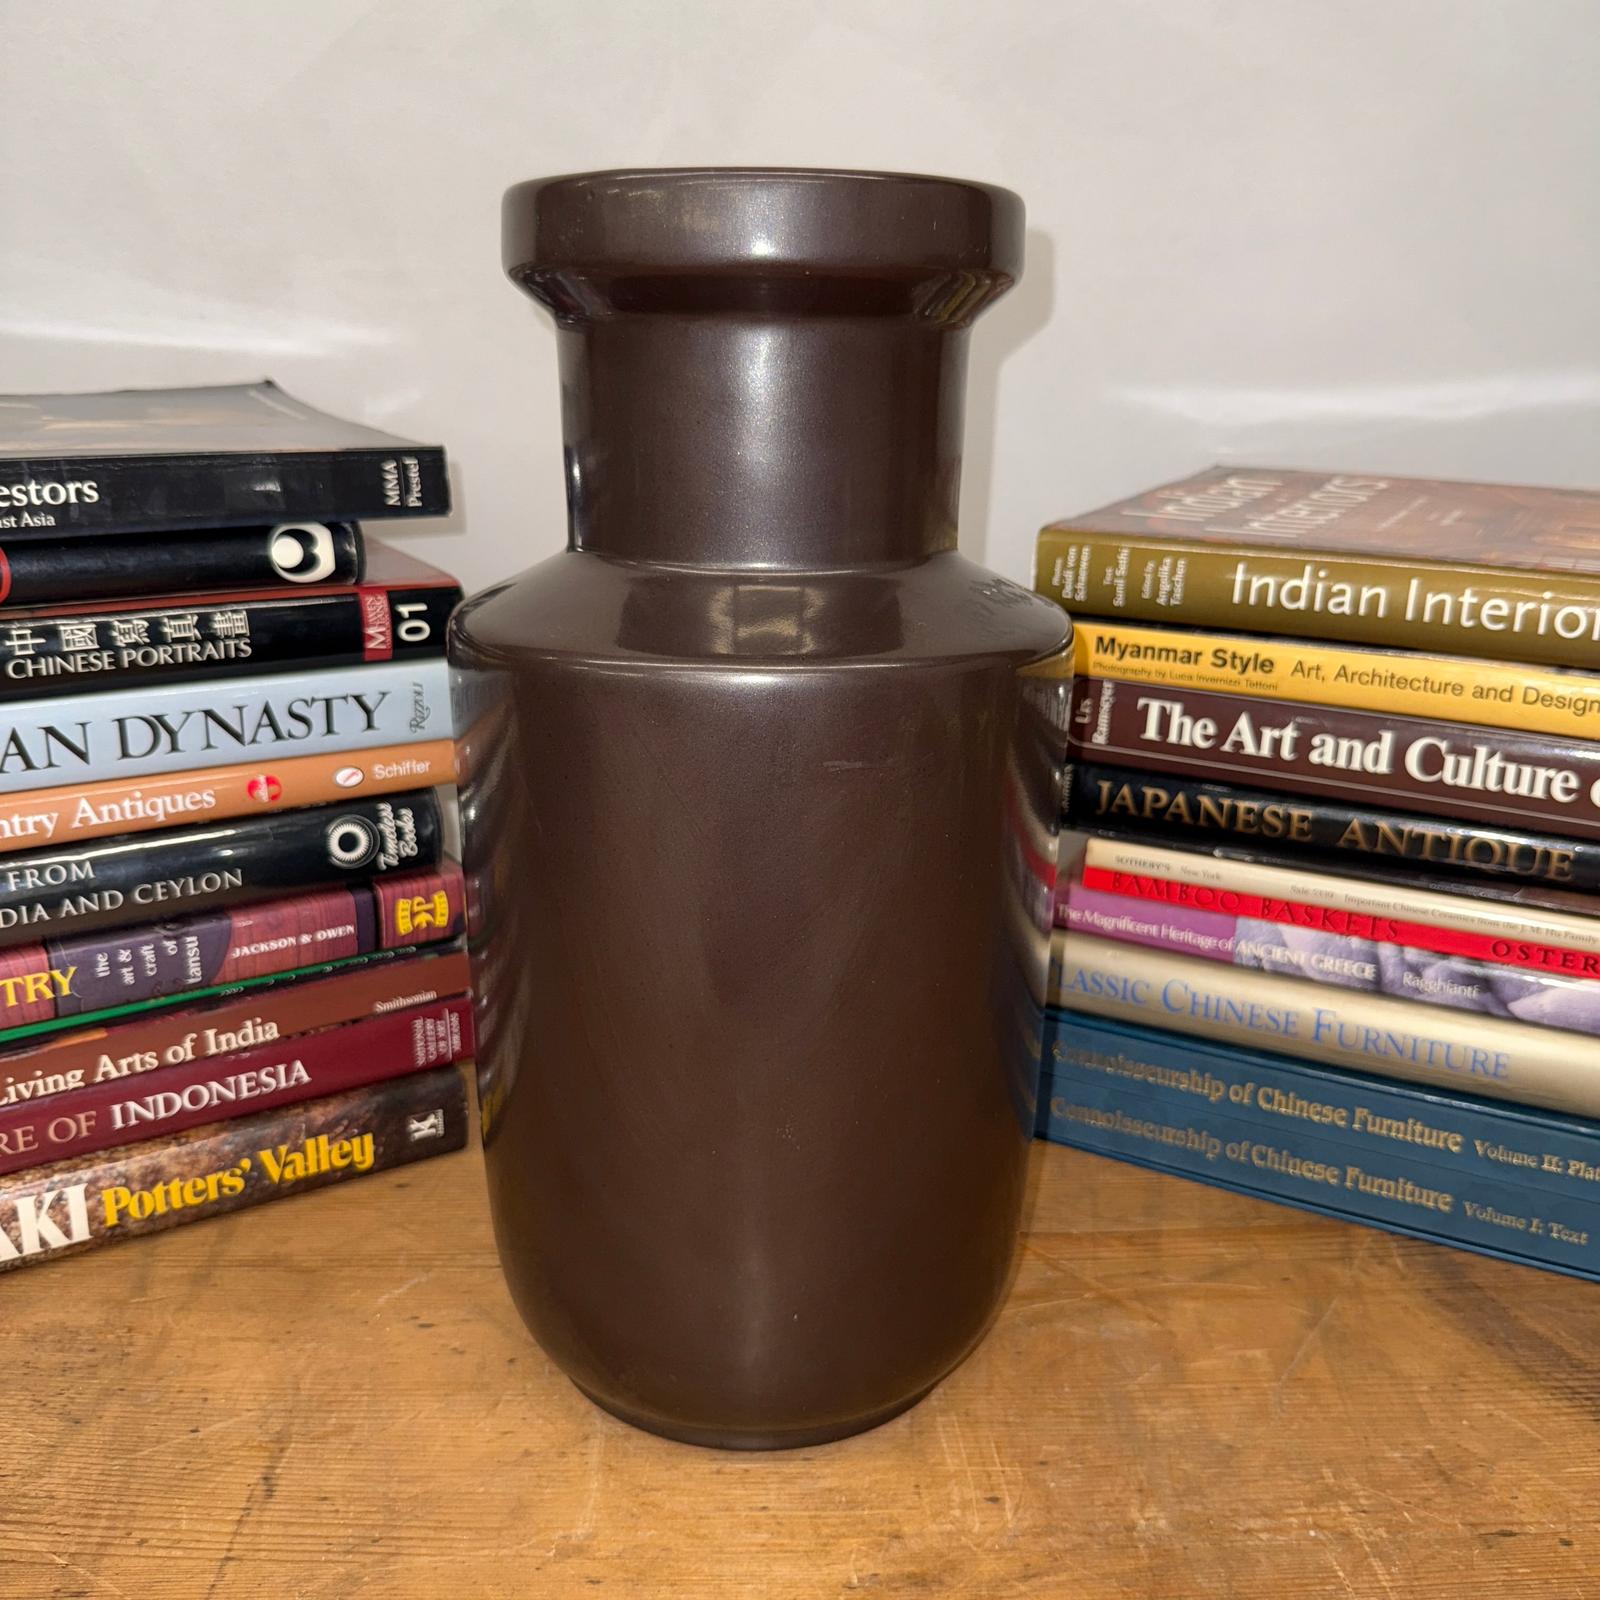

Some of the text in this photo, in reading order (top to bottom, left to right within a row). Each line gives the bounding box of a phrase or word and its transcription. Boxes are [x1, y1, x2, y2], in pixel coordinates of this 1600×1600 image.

[381, 459, 401, 506] MMA
[402, 456, 423, 508] Prestel
[20, 510, 56, 528] Asia
[1113, 577, 1126, 607] Sunil
[1170, 559, 1187, 607] Taschen
[1232, 561, 1388, 618] Indian
[395, 601, 431, 643] 01
[5, 637, 253, 680] CHINESE PORTRAITS
[1093, 661, 1152, 677] Photography
[1155, 669, 1167, 679] by
[1094, 636, 1600, 717] Myanmar Style Art, Architecture and Design
[0, 691, 391, 774] AN DYNASTY
[1136, 696, 1218, 748] The
[1218, 710, 1300, 761] Art
[1307, 729, 1394, 775] and
[1404, 735, 1581, 802] Culture
[373, 759, 432, 780] Schiffer
[71, 789, 217, 829] Antiques
[396, 807, 418, 858] Books
[1097, 779, 1314, 842] JAPANESE
[1335, 818, 1576, 882] ANTIQUE
[376, 801, 400, 870] Timeless
[0, 868, 244, 930] DIA AND CEYLON
[7, 859, 96, 892] FROM
[1115, 854, 1171, 873] SOTHEBY'S
[1180, 864, 1199, 877] New
[1200, 869, 1221, 881] York
[1344, 893, 1391, 912] Important
[1477, 916, 1501, 928] from
[1502, 919, 1519, 930] the
[1562, 930, 1600, 945] Family
[162, 940, 179, 956] of
[231, 924, 356, 960] JACKSON & OWEN
[1111, 871, 1600, 975] BAMBOO BASKETS OSTER
[95, 952, 112, 978] the
[118, 948, 136, 985] art &
[140, 943, 158, 977] craft
[185, 935, 203, 984] tansu
[1058, 904, 1481, 998] The Magnificent Heritage of ANCIENT GREECE Ragghianti
[0, 966, 78, 1007] TRY
[375, 990, 438, 1014] Smithsonian
[94, 1050, 159, 1083] Arts
[165, 1032, 196, 1066] of
[202, 1016, 280, 1056] India
[1160, 979, 1299, 1039] CHINESE
[1312, 1006, 1512, 1080] FURNITURE
[48, 1110, 97, 1144] OF
[110, 1059, 313, 1131] INDONESIA
[1051, 1039, 1225, 1104] Connoisseurship
[1229, 1081, 1256, 1105] of
[1257, 1085, 1349, 1128] Chinese
[1351, 1105, 1465, 1154] Furniture
[1473, 1139, 1539, 1169] Volume
[258, 1131, 376, 1185] Valley
[1050, 1097, 1222, 1161] Connoisseurship
[1225, 1139, 1251, 1163] of
[1251, 1143, 1341, 1186] Chinese
[1344, 1164, 1454, 1214] Furniture
[1463, 1199, 1528, 1230] Volume
[1547, 1222, 1590, 1247] Text
